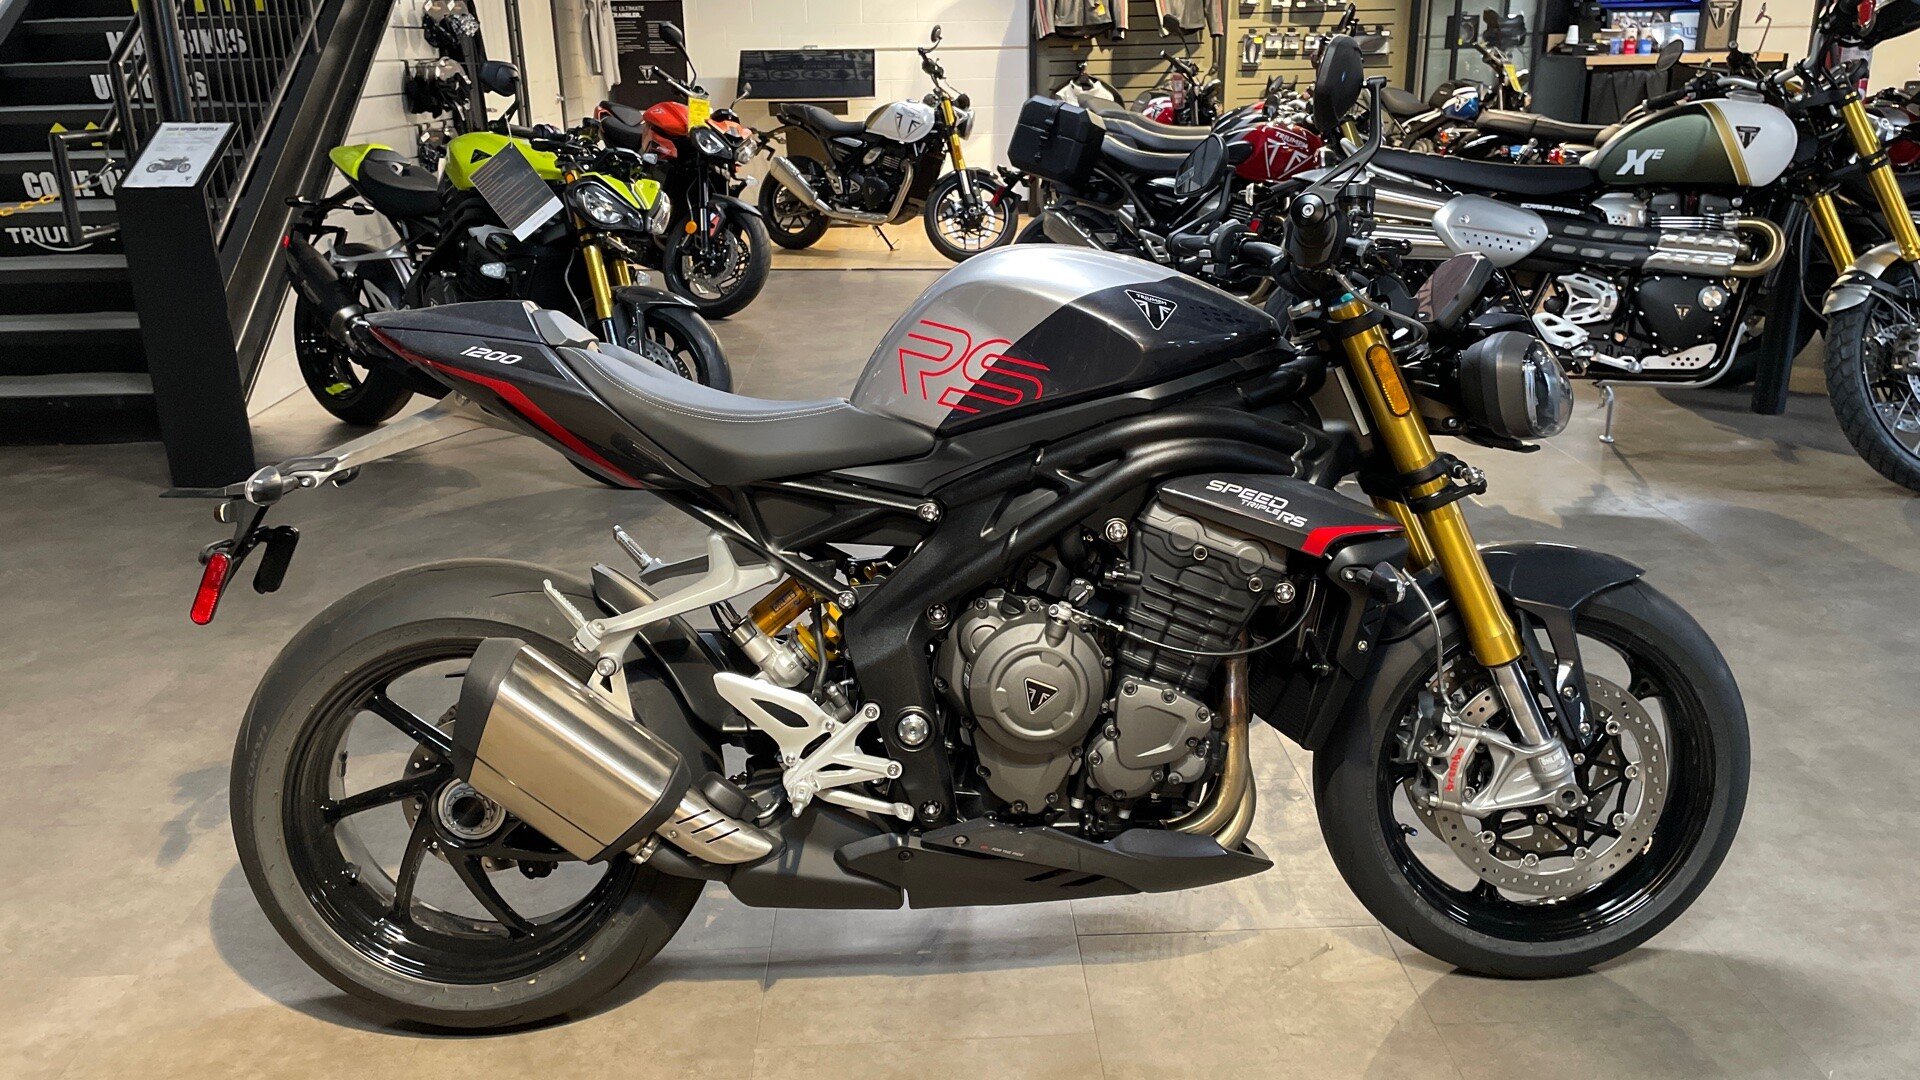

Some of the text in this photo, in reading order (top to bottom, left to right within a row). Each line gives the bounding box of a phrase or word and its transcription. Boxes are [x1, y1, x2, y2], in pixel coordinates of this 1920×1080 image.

[459, 345, 523, 365] 1200
[898, 318, 1051, 415] RS
[1205, 479, 1289, 510] SPEED
[1241, 498, 1308, 528] TRIPLE RS
[1444, 747, 1465, 792] brembo
